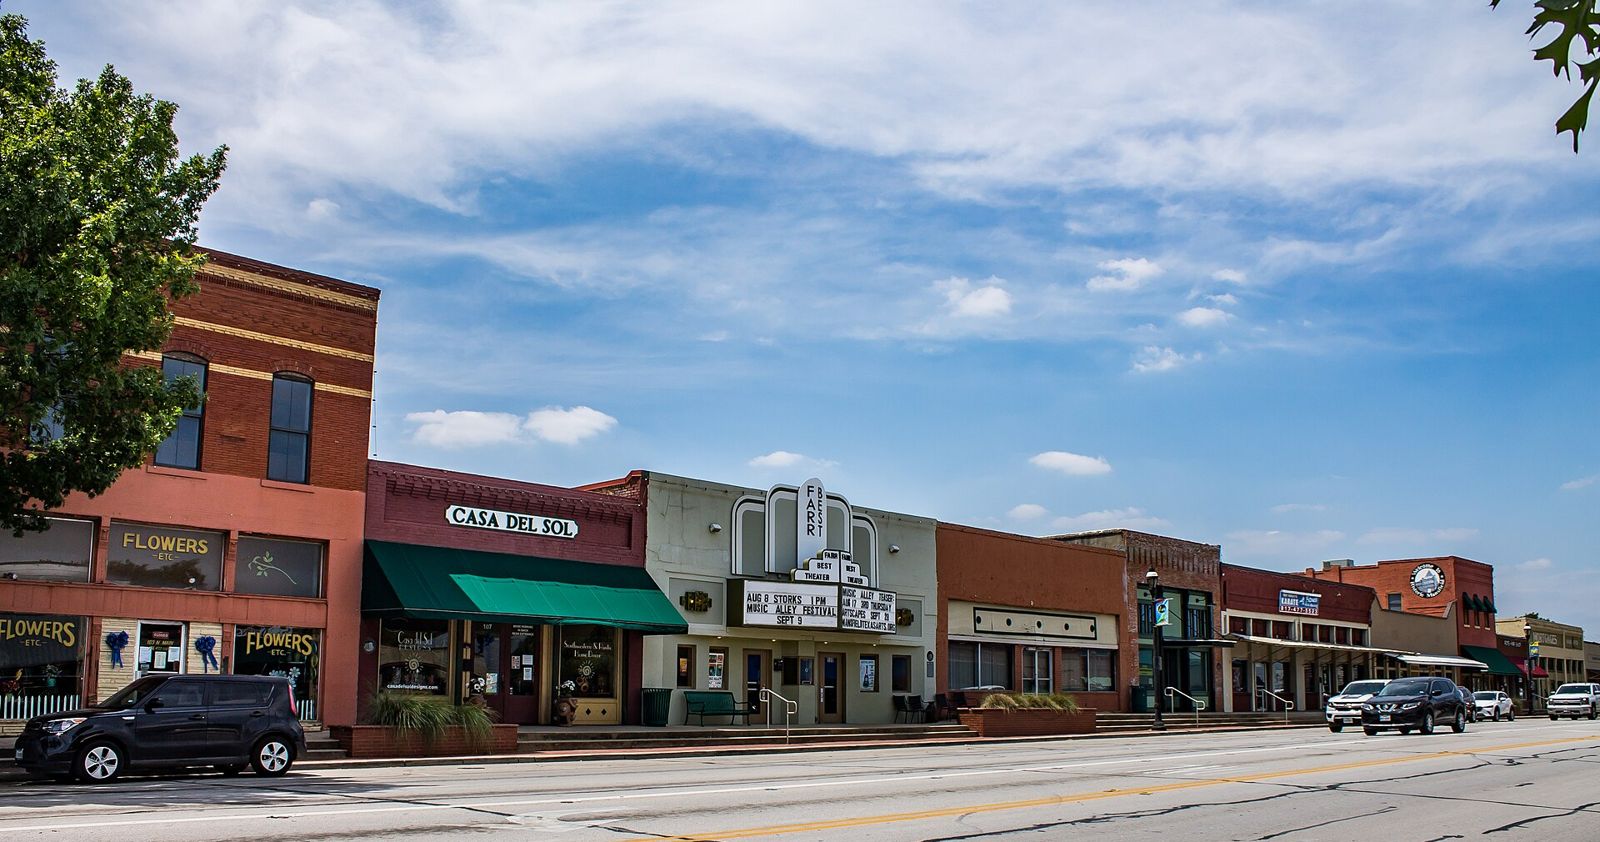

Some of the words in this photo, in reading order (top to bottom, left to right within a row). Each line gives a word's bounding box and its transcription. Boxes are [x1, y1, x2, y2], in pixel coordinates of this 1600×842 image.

[806, 485, 816, 536] FARR
[452, 507, 500, 528] CASA
[506, 514, 537, 532] DEL
[542, 519, 573, 536] SOL
[123, 532, 209, 555] FLOWERS
[816, 562, 832, 570] BEST
[845, 565, 856, 573] BEST
[804, 572, 830, 581] THEATER
[847, 576, 863, 585] THEATER
[747, 593, 762, 603] AUG
[764, 594, 769, 603] 8
[773, 594, 802, 605] STORKS
[815, 596, 827, 606] PM
[842, 587, 857, 598] MUSIC
[860, 590, 874, 600] ALLEY
[746, 603, 769, 614] MUSIC
[775, 605, 797, 614] ALLEY
[803, 606, 837, 617] FESTIVAL
[851, 599, 857, 609] 17
[870, 601, 892, 612] THURSDAY
[776, 615, 794, 625] SEPT
[797, 616, 803, 625] 9
[0, 619, 75, 647] FLOWERS
[246, 631, 313, 656] FLOWERS
